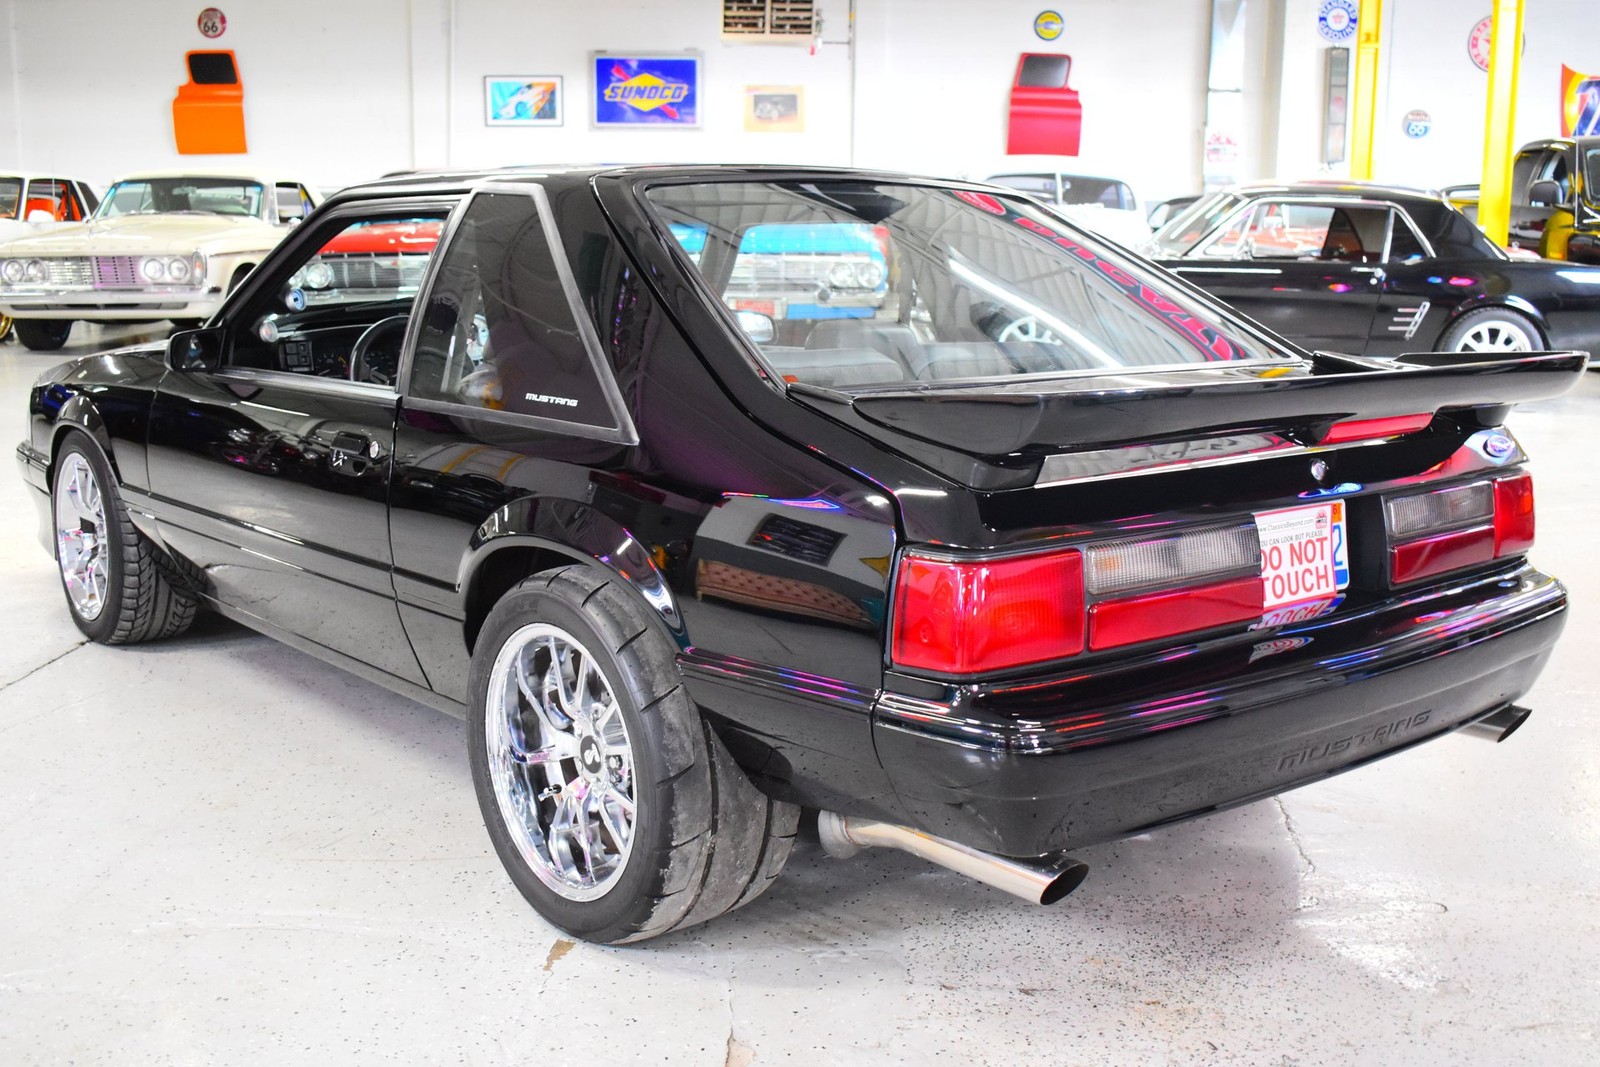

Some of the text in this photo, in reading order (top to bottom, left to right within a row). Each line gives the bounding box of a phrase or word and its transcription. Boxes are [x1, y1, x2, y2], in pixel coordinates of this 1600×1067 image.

[203, 21, 218, 33] 66
[608, 85, 684, 100] SUNOCO
[525, 392, 579, 407] MUSTANG
[1269, 537, 1280, 546] CAN
[1281, 535, 1294, 544] LOOK
[1295, 532, 1304, 541] BUT
[1305, 529, 1323, 539] PLEASE
[1289, 536, 1328, 567] NOT
[1263, 564, 1330, 602] TOUCH
[1276, 709, 1432, 772] MUSTANG
